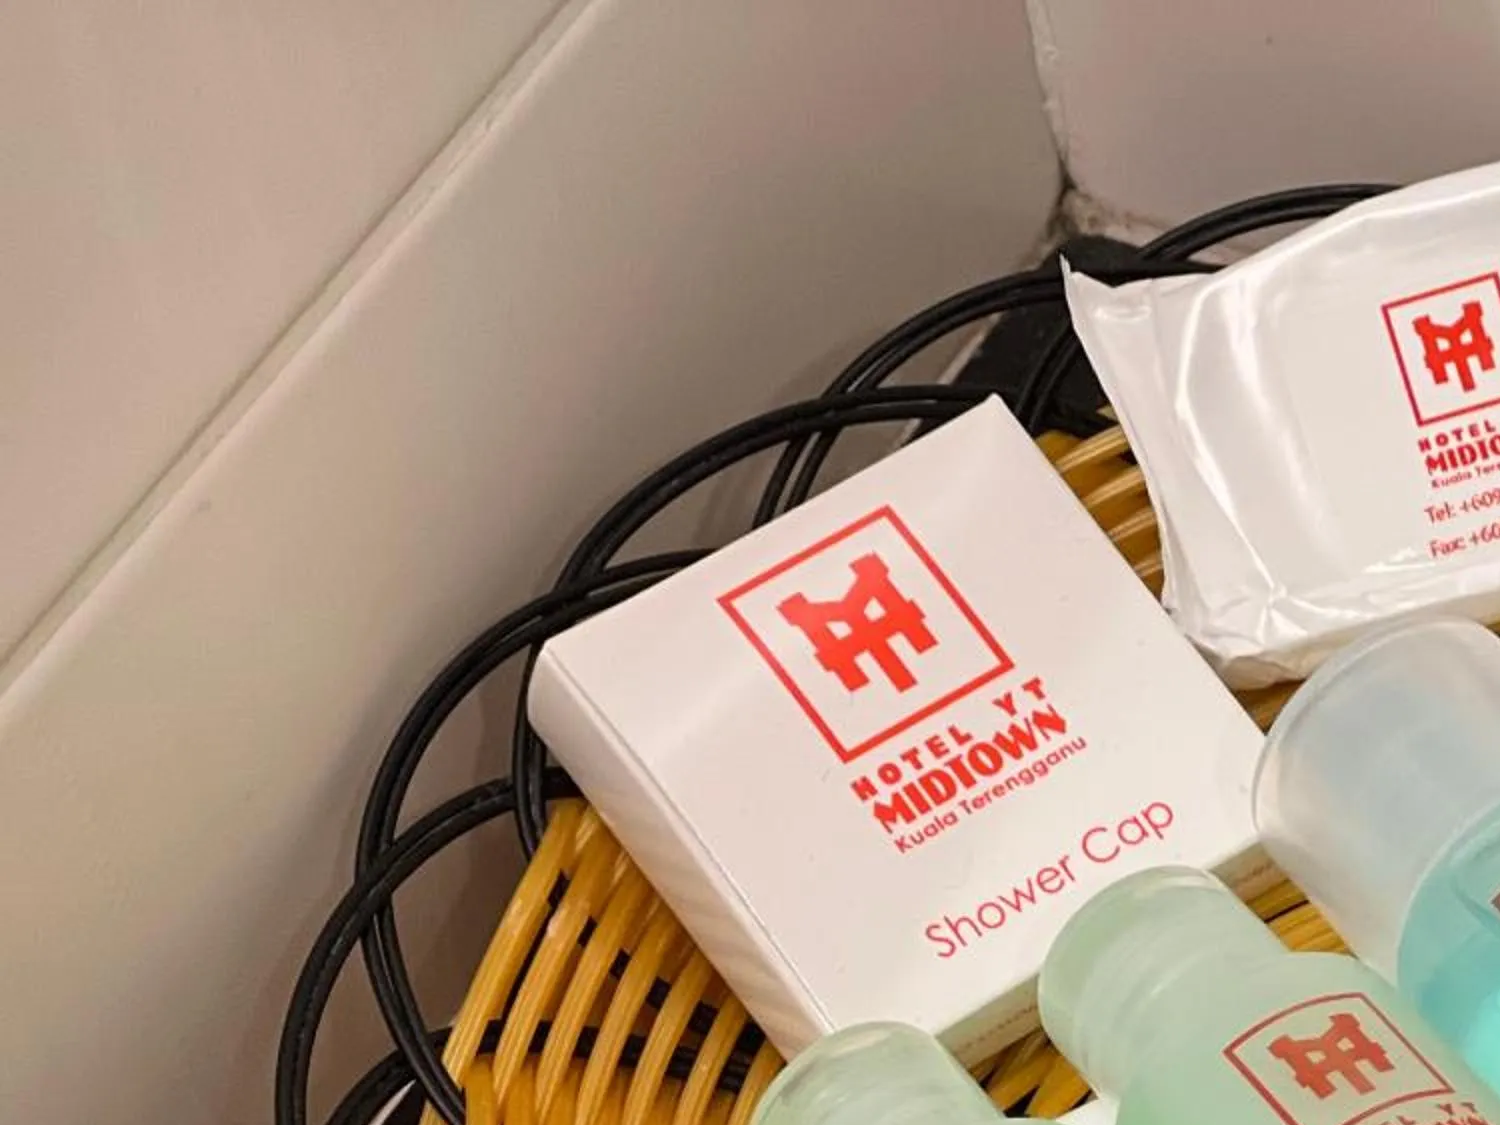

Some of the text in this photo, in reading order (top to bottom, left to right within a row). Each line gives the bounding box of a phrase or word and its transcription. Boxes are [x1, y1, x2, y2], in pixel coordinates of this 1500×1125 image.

[1418, 419, 1496, 452] HOTEL
[1424, 502, 1457, 524] Tel:
[1431, 471, 1472, 489] Kuala
[850, 725, 973, 801] HOTEL
[873, 703, 1067, 835] MIDTOWN
[894, 736, 1087, 854] Kuala Terengganu
[925, 800, 1175, 960] Shower Cap
